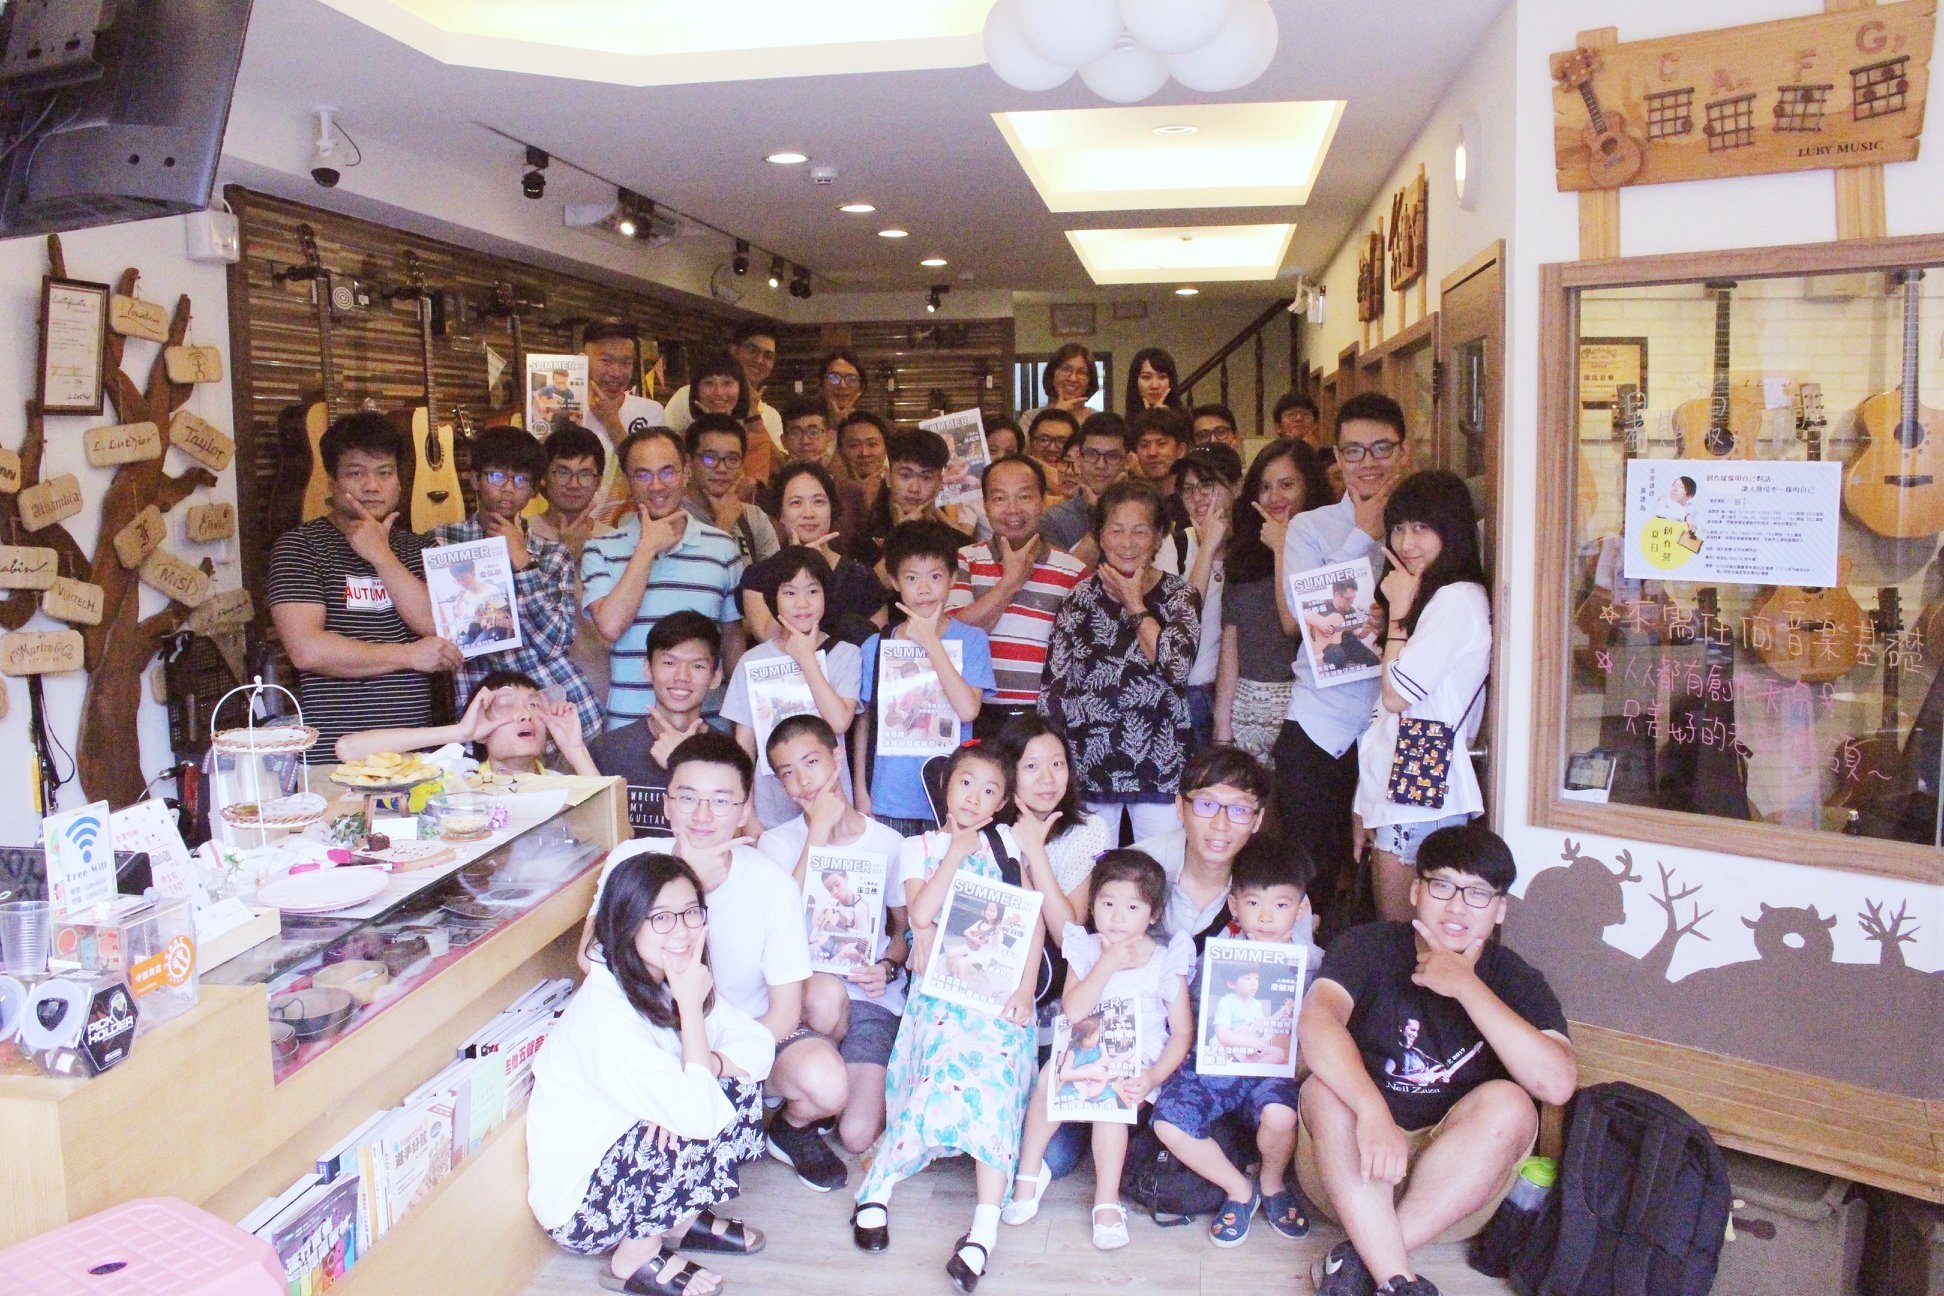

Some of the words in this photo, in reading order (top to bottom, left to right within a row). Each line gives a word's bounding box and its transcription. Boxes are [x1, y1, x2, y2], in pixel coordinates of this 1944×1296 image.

[1656, 52, 1681, 82] C
[1794, 49, 1818, 83] F
[1799, 143, 1834, 158] LUBY
[1838, 140, 1884, 155] MUSIC
[529, 360, 576, 371] SUMMER
[185, 425, 226, 461] Taylor
[427, 546, 492, 568] SUMMER
[1294, 567, 1357, 592] SUMMER
[344, 585, 386, 601] AUTUM
[883, 646, 929, 659] SUMM
[749, 662, 801, 681] SUMME
[630, 803, 643, 812] MY
[629, 813, 666, 825] GUITAR
[810, 855, 872, 874] SUMMER
[953, 878, 1023, 910] SUMMER
[1209, 945, 1286, 965] SUMMER
[88, 1016, 114, 1036] PICK
[88, 1016, 134, 1046] HOLDER
[505, 1033, 549, 1077] 吉他五聲音
[1385, 1081, 1409, 1093] Neil
[1411, 1086, 1441, 1094] Zaza
